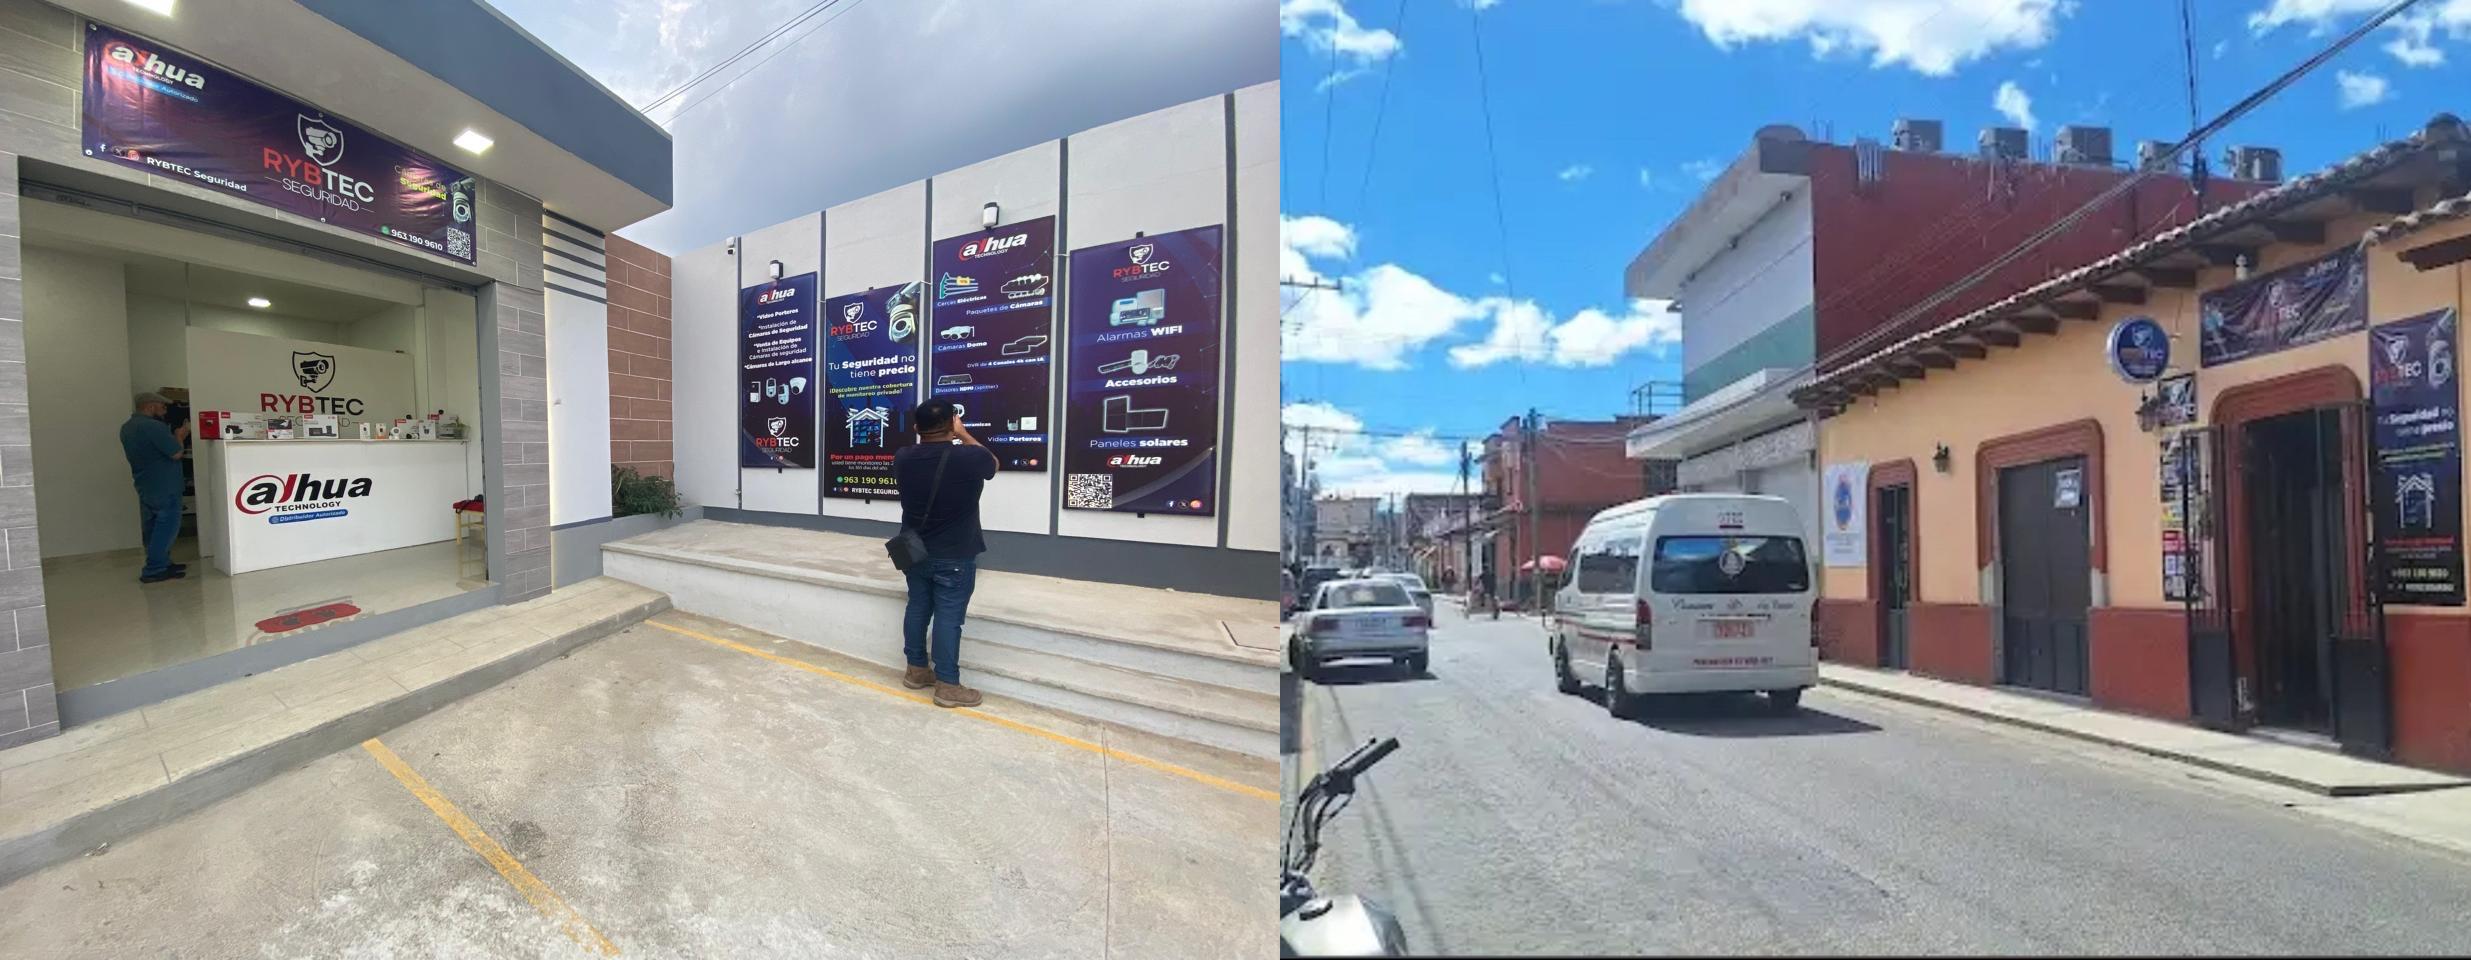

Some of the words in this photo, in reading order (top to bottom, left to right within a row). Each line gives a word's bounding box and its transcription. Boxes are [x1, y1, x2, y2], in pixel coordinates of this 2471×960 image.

[146, 156, 192, 176] RYBTEC
[193, 170, 247, 191] Seguridad
[263, 147, 375, 203] RYBTEC
[282, 178, 359, 211] SEGURIDAD
[391, 229, 408, 240] 963
[408, 235, 424, 245] 190
[424, 239, 443, 251] 9610
[1113, 261, 1170, 278] RYBTEC
[966, 307, 998, 315] Paquetes
[1010, 300, 1044, 309] Cámaras
[830, 320, 878, 336] RYBTEC
[1096, 329, 1148, 342] Alarmas
[1150, 325, 1183, 337] WIFI
[828, 362, 840, 371] Tu
[901, 355, 916, 363] no
[850, 369, 877, 379] tiene
[878, 365, 916, 377] precio
[1105, 375, 1178, 388] Accesorios
[260, 393, 364, 416] RYBTEC
[756, 436, 799, 448] RYBTEC
[1090, 439, 1137, 448] Paneles
[1139, 438, 1188, 447] solares
[855, 454, 874, 462] pago
[843, 476, 859, 484] 963
[861, 476, 877, 485] 190
[274, 500, 342, 513] TECHNOLOGY
